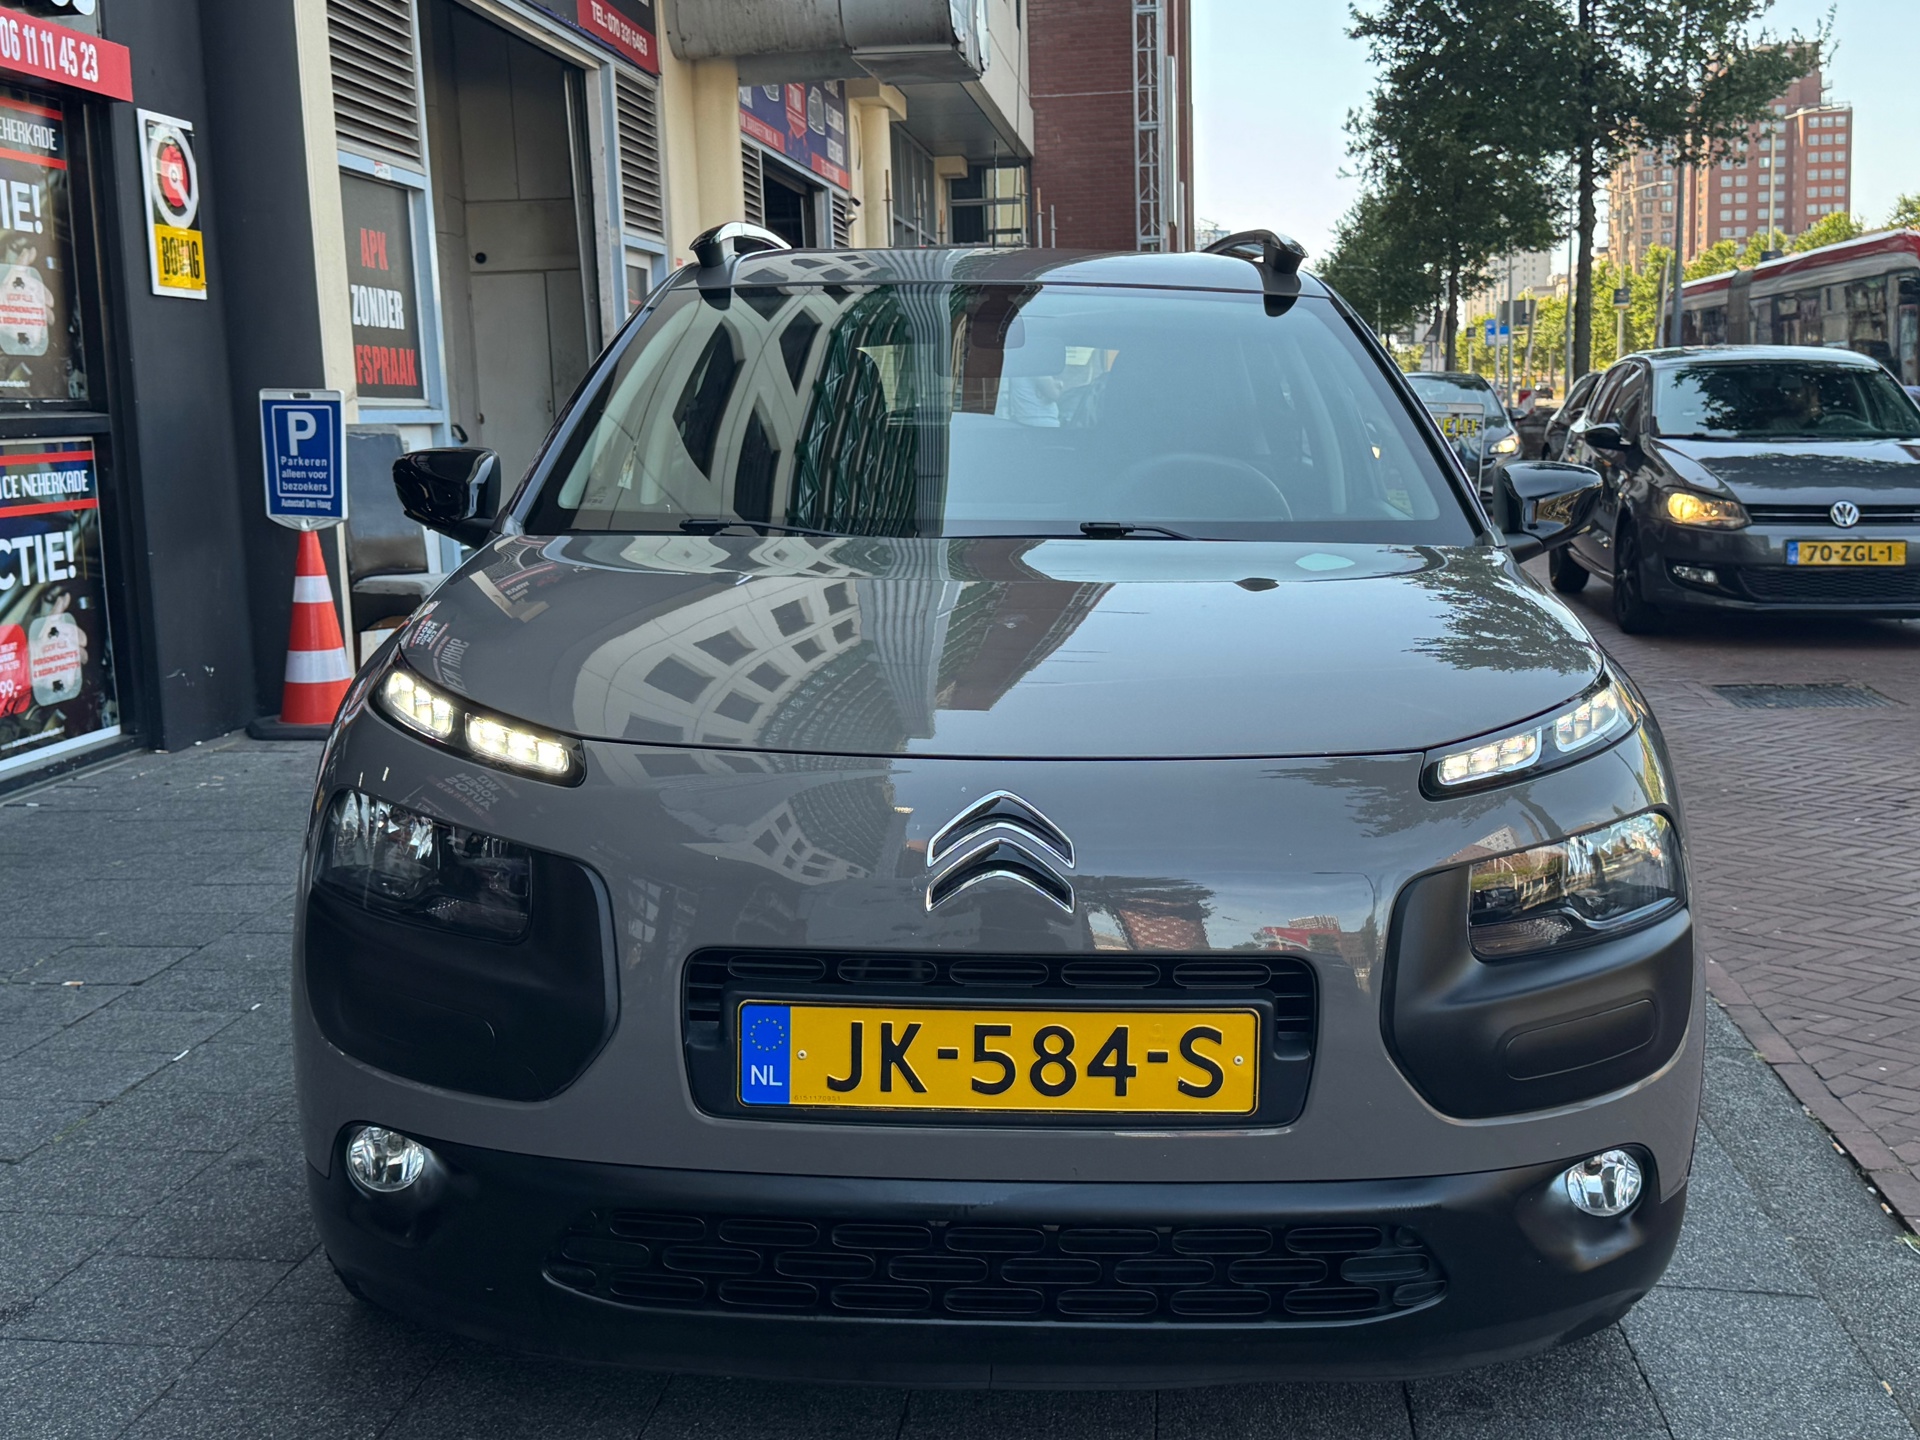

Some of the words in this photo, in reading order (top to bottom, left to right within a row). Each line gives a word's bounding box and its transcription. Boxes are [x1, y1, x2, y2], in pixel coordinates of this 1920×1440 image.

[0, 16, 21, 61] 06
[22, 24, 39, 66] 11
[40, 29, 56, 71] 11
[59, 36, 78, 77] 45
[80, 41, 99, 83] 23
[360, 227, 388, 270] APK
[350, 284, 405, 330] ZONDER
[355, 344, 417, 386] FSPRAAK
[287, 411, 317, 456] P
[280, 456, 327, 467] Parkeren
[281, 470, 306, 479] alleen
[308, 471, 328, 479] voor
[21, 470, 89, 497] NEHERKADE
[282, 481, 328, 492] bezoekers
[1806, 545, 1893, 562] 70-ZGL-1
[750, 1064, 783, 1086] NL
[826, 1020, 1224, 1098] JK-584-S
